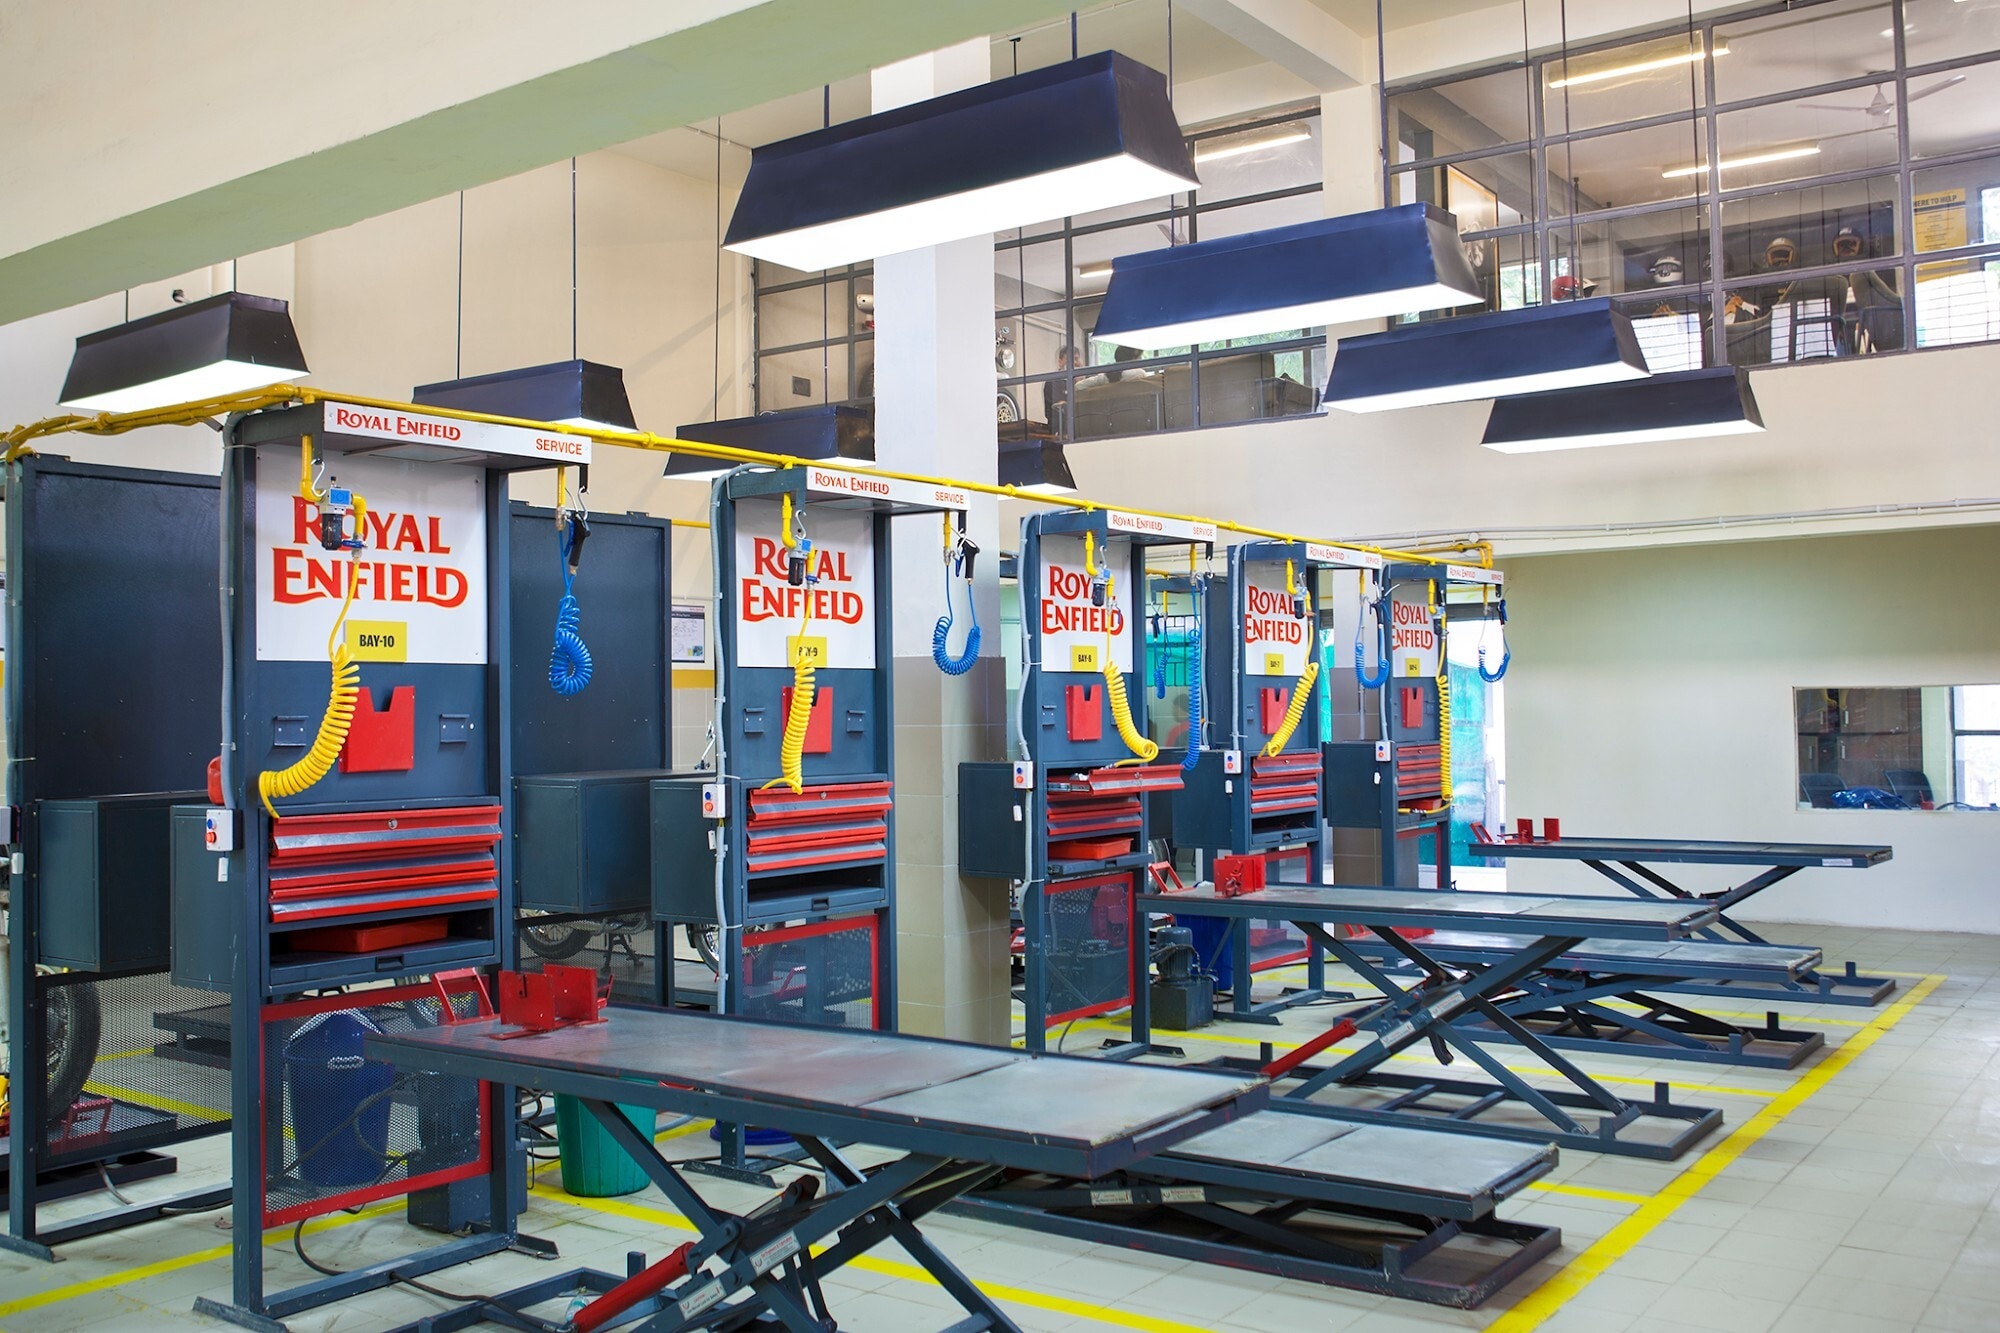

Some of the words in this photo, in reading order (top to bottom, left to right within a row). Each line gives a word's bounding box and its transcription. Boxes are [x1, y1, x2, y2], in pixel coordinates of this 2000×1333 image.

[337, 407, 392, 432] ROYAL
[396, 416, 461, 441] ENFIELD
[536, 438, 582, 456] SERVICE
[815, 472, 848, 489] ROYAL
[850, 477, 890, 495] ENFIELD
[934, 490, 965, 505] SERVICE
[1112, 514, 1135, 528] ROYAL
[1136, 517, 1163, 532] ENFIELD
[1192, 526, 1213, 538] SERVICE
[271, 546, 469, 608] ENFIELD
[742, 577, 864, 625] ENFIELD
[1041, 598, 1125, 637] ENFIELD
[1392, 600, 1429, 626] ROYAL
[359, 633, 395, 649] BAY-10
[1244, 613, 1302, 645] ENFIELD
